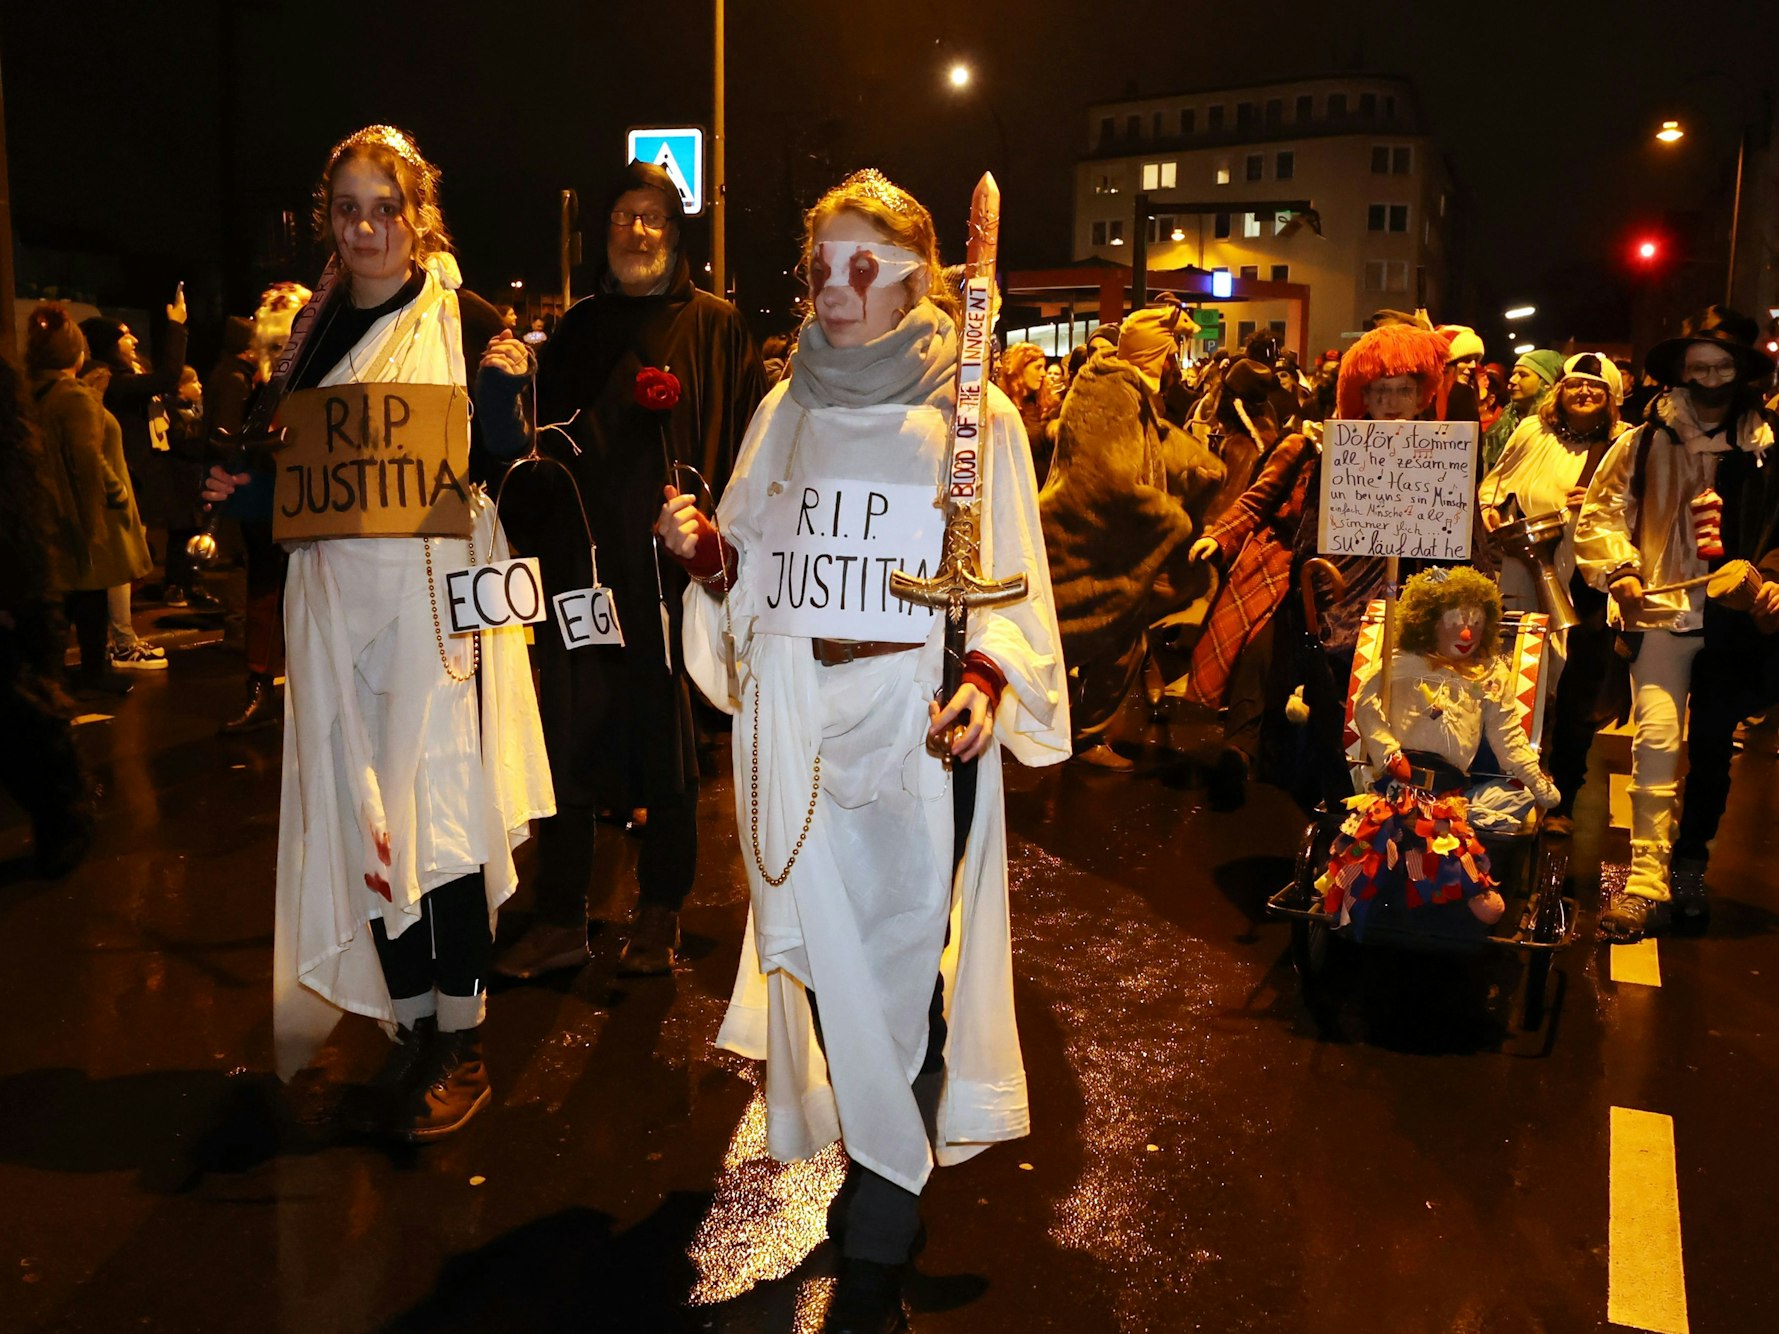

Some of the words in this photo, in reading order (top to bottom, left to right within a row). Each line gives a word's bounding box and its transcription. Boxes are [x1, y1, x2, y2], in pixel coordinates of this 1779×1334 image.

[962, 285, 986, 366] INNOCENT
[1207, 341, 1216, 351] P
[959, 385, 980, 408] THE
[956, 416, 977, 438] OF
[1402, 425, 1471, 451] stommer
[1334, 450, 1360, 467] all
[1370, 451, 1385, 467] he
[950, 450, 976, 497] BLOOD
[1332, 468, 1379, 488] ohne
[1388, 471, 1430, 493] Hass
[282, 458, 470, 518] JUSTITIA
[1331, 491, 1346, 500] un
[1355, 490, 1371, 501] bei
[1411, 496, 1427, 505] sin
[1337, 519, 1389, 530] simmer
[1418, 509, 1444, 522] all
[1411, 537, 1437, 557] dat
[1444, 538, 1466, 558] he
[446, 562, 539, 632] ECO
